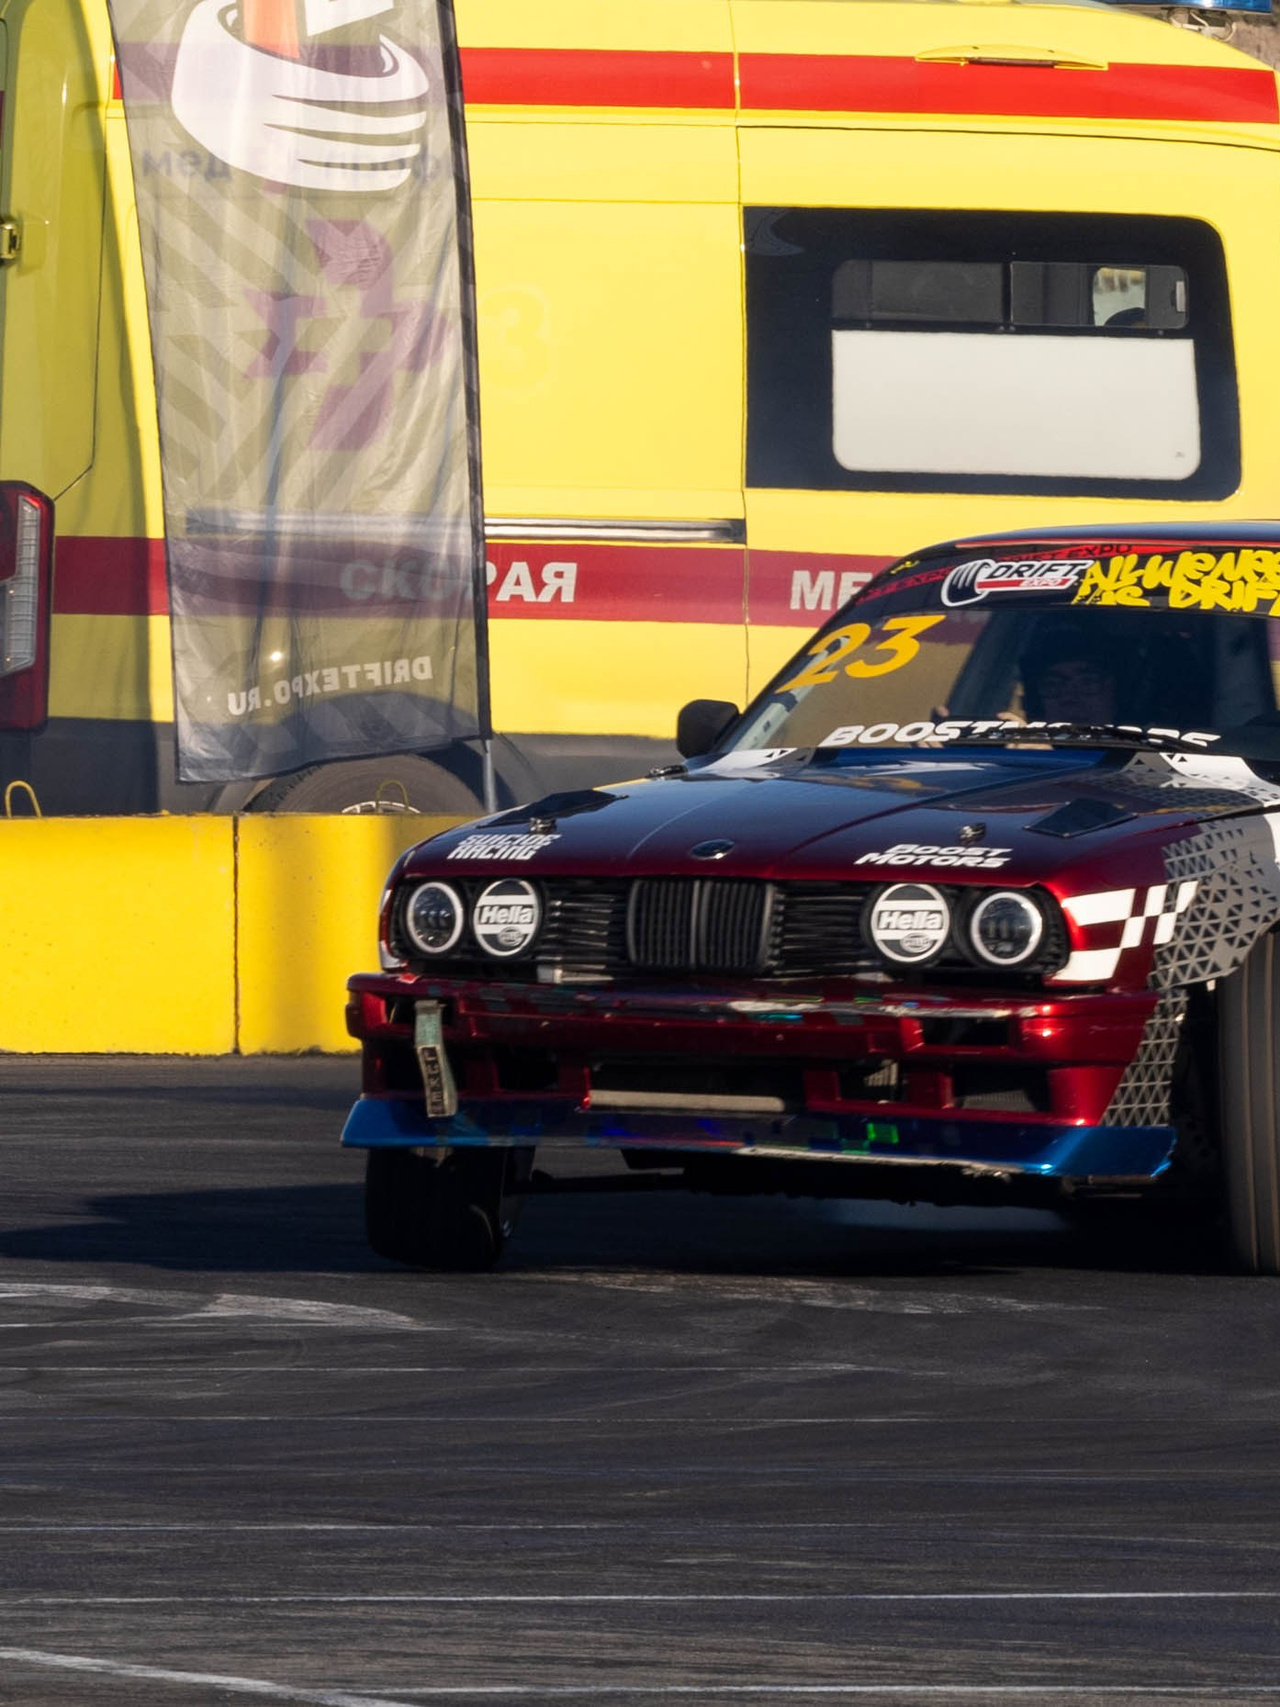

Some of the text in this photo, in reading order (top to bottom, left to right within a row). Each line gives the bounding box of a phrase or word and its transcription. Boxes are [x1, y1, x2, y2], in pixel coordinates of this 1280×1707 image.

[985, 562, 1090, 579] DRIFT
[775, 614, 947, 693] 23
[458, 834, 561, 848] SUICIDE
[446, 845, 537, 860] RACING
[883, 844, 1014, 856] BOOST
[853, 852, 1011, 868] MOTORS
[480, 905, 533, 924] Hella
[879, 910, 943, 930] Hella
